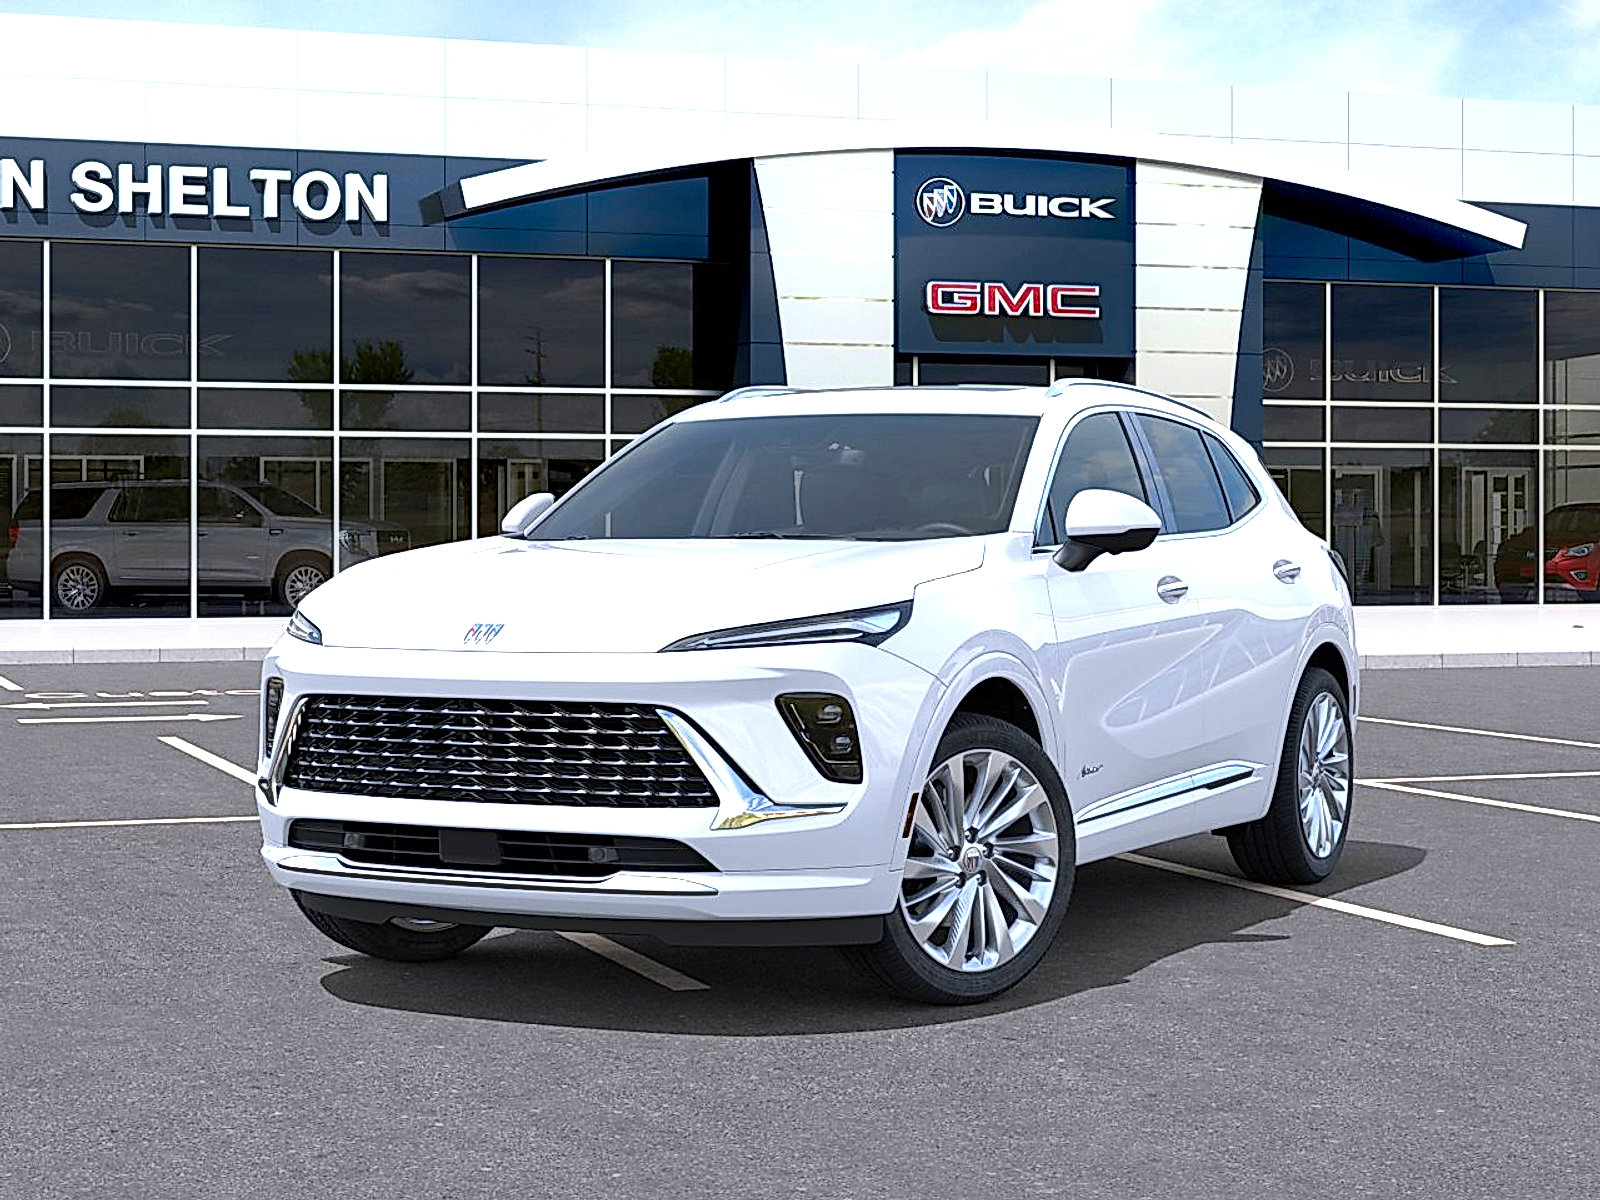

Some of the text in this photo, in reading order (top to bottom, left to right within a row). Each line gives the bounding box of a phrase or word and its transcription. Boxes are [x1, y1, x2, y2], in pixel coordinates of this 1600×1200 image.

[69, 160, 389, 222] SHELTON
[970, 192, 1117, 219] BUICK
[926, 280, 1101, 318] GMC
